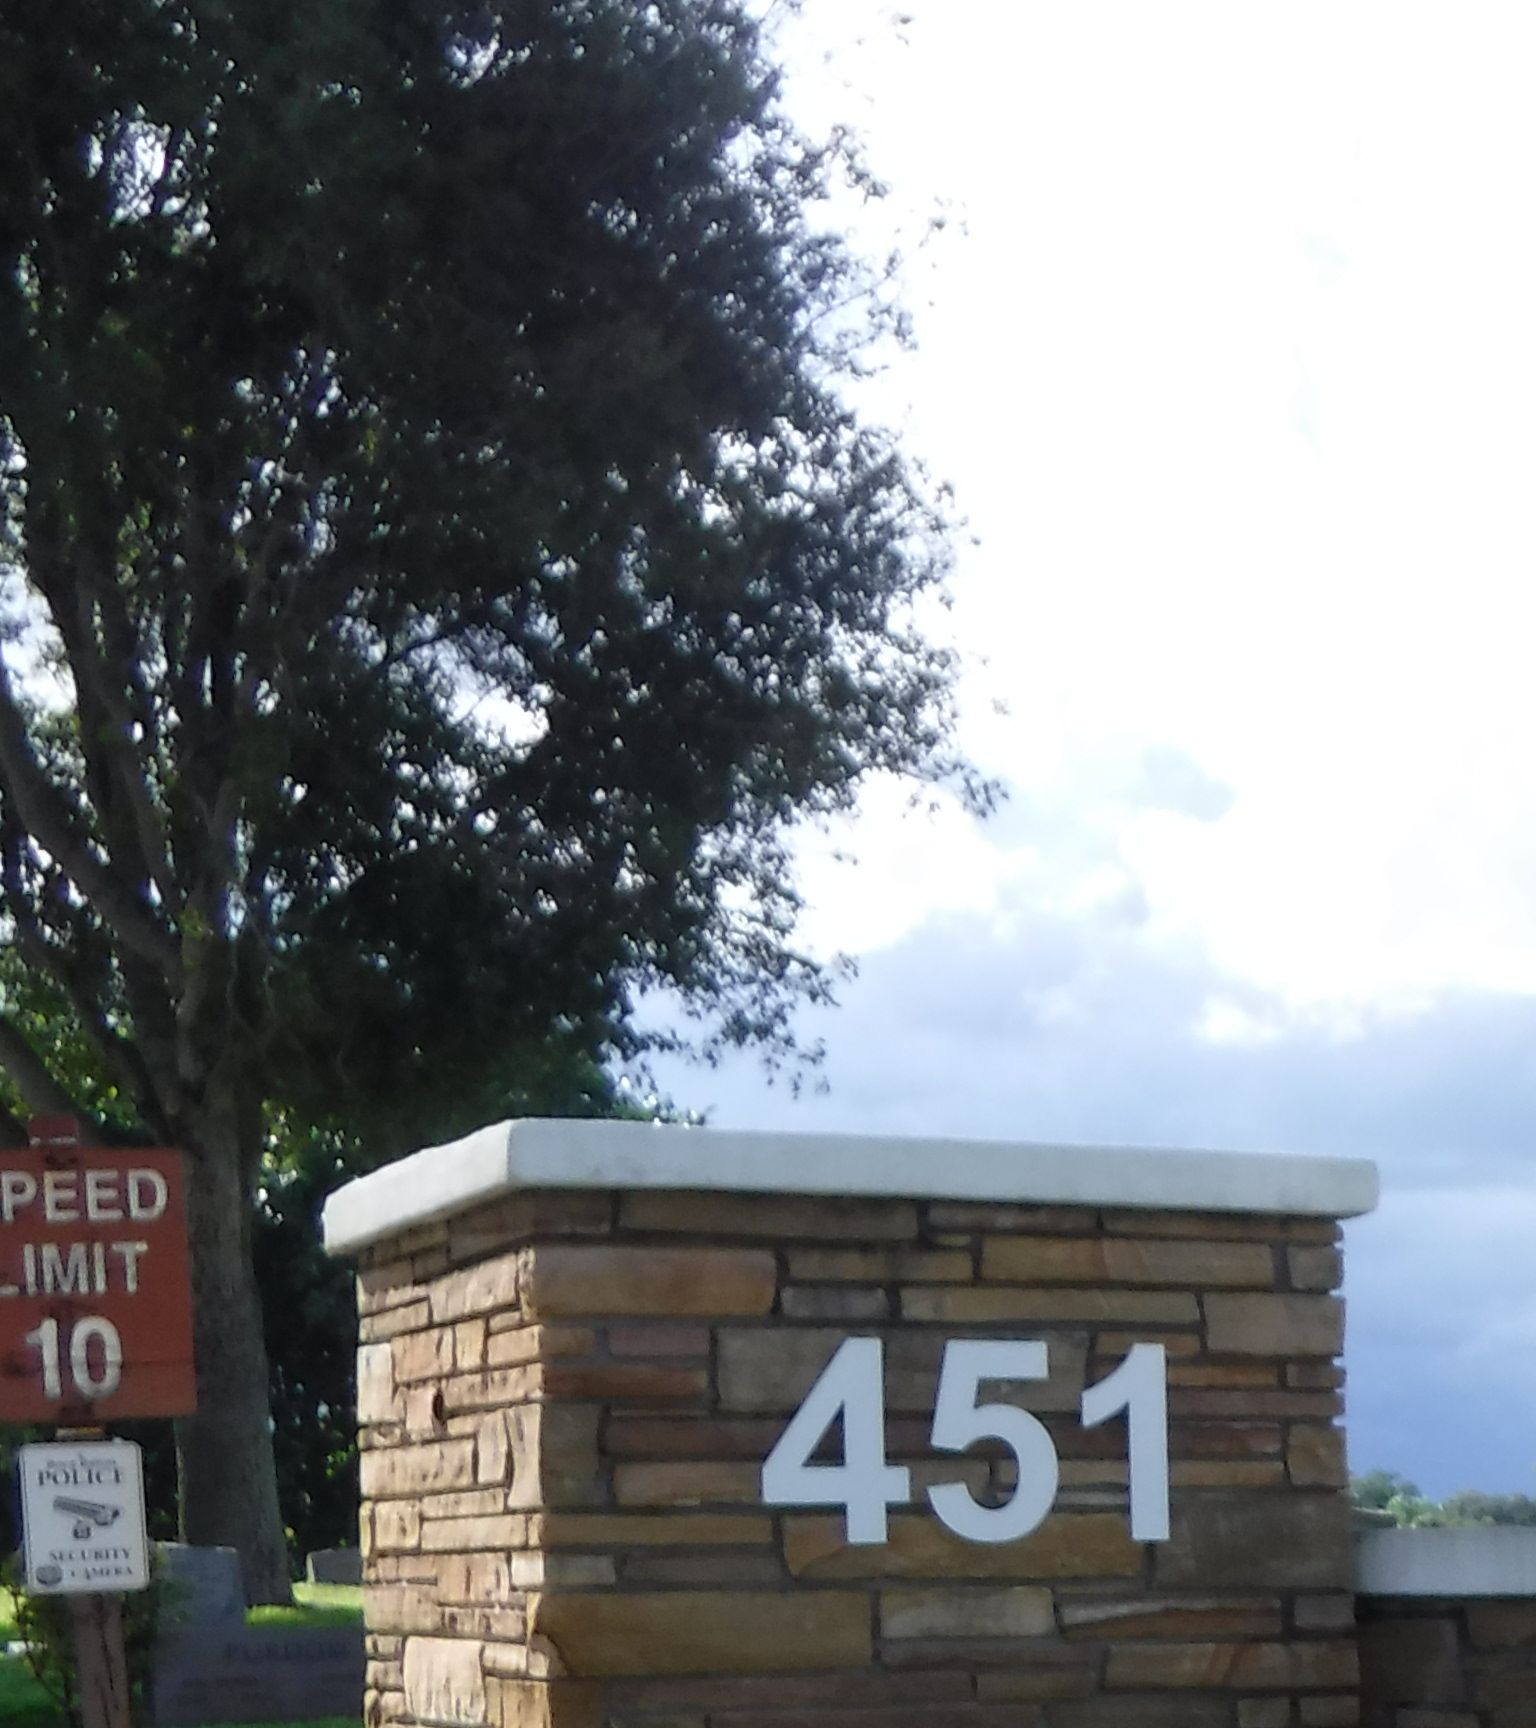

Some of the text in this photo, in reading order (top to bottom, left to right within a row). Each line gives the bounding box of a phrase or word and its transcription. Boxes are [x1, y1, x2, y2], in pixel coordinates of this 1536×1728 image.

[1, 1168, 167, 1222] PEED
[0, 1240, 148, 1296] IMIT
[26, 1315, 123, 1397] 10
[761, 1337, 1171, 1545] 451
